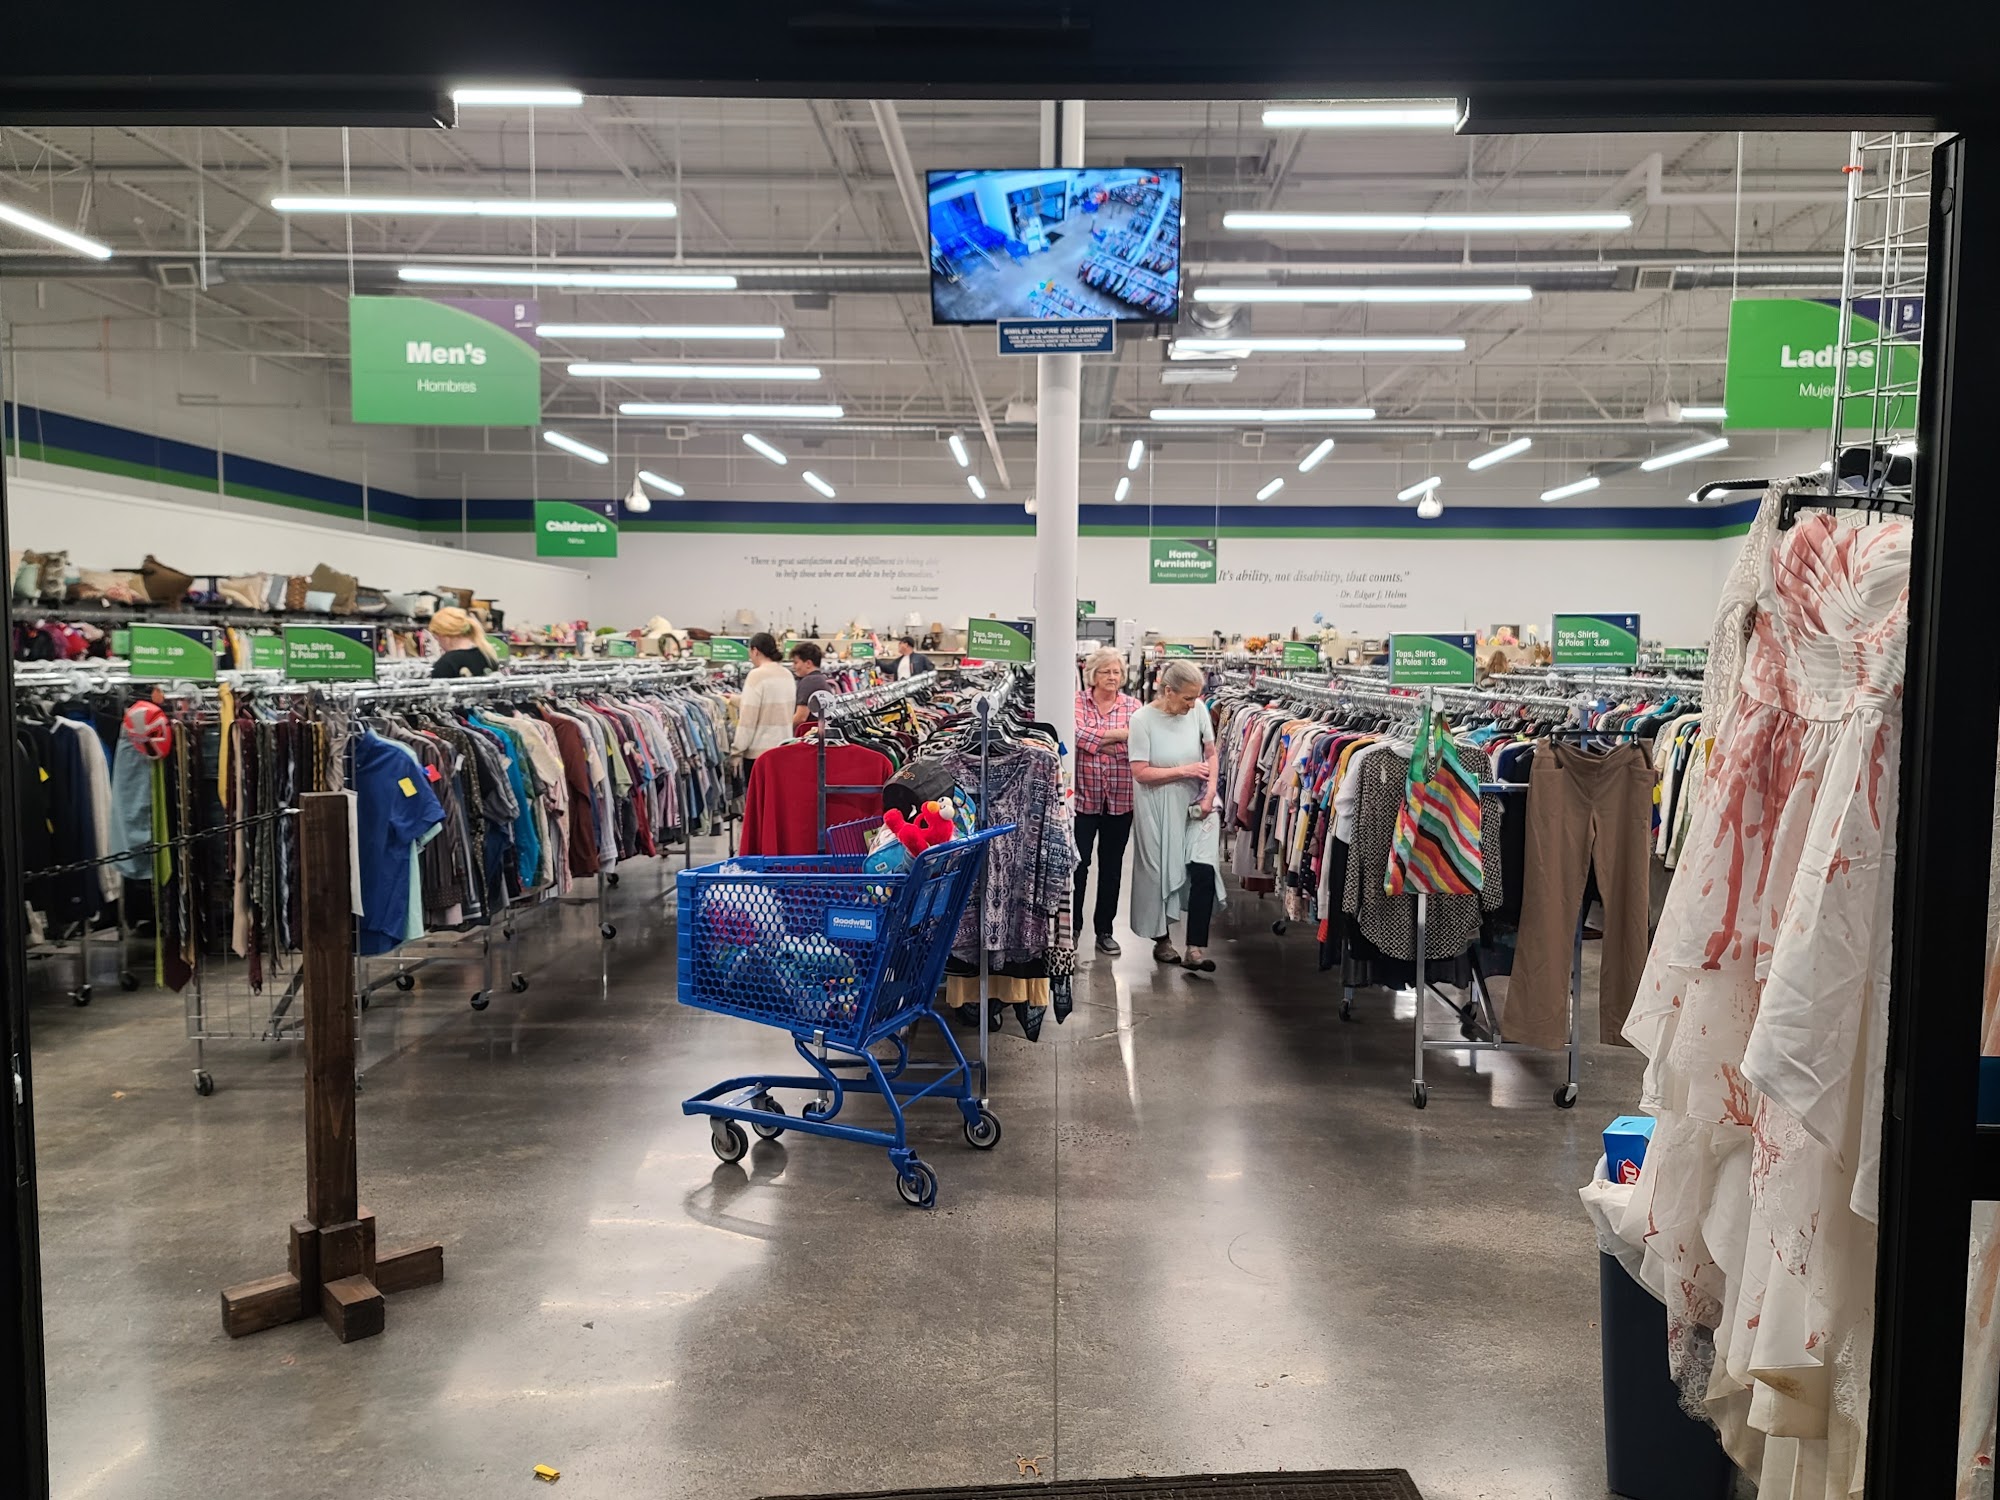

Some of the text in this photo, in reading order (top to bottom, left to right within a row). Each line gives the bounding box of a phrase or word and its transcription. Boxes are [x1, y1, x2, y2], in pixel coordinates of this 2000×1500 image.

[406, 341, 486, 364] Men's
[417, 380, 477, 393] Hombres
[546, 520, 608, 533] Children's
[1168, 550, 1198, 559] Home
[1154, 559, 1212, 569] Furnishings
[1218, 570, 1233, 582] It's
[1235, 570, 1272, 584] ability,
[1275, 572, 1290, 582] not
[1293, 570, 1343, 585] disability,
[1346, 571, 1367, 582] that
[1340, 590, 1352, 598] Dr.
[1354, 590, 1375, 600] Edgar
[1384, 590, 1407, 598] Helms
[1395, 650, 1414, 658] Tops,
[833, 917, 866, 926] Goodwill
